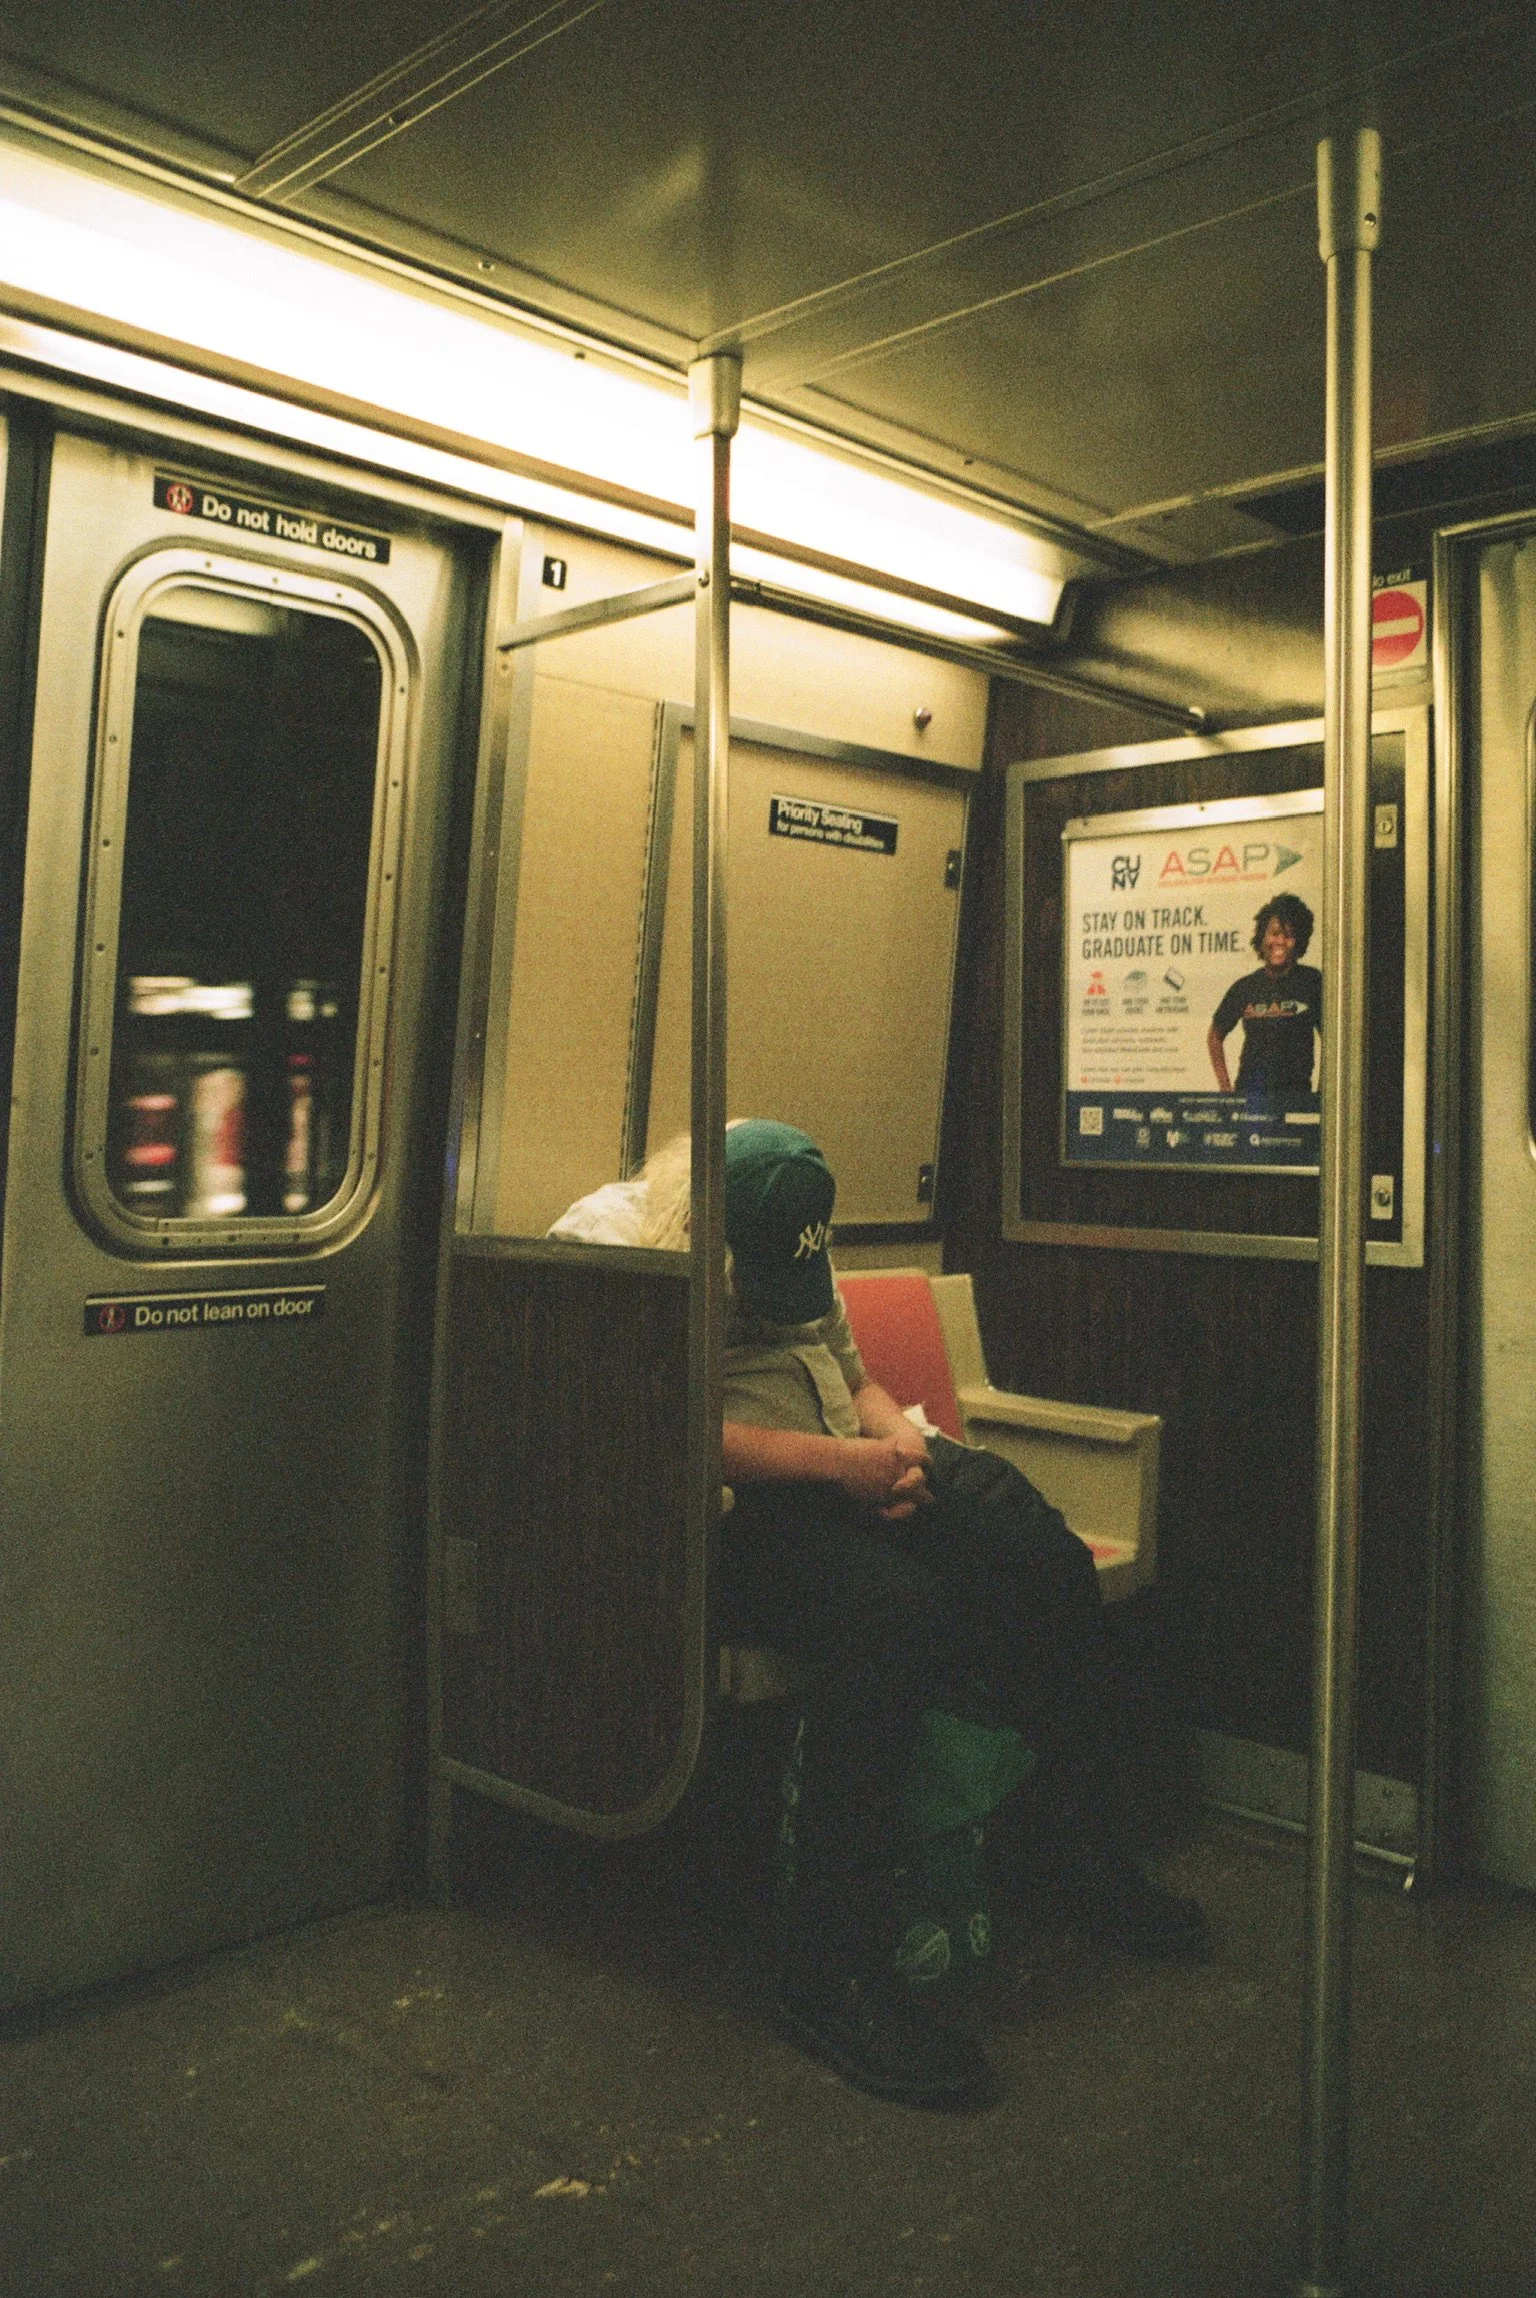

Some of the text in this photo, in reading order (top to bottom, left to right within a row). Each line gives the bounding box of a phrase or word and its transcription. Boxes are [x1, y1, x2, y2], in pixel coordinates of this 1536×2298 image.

[202, 495, 376, 559] Do not hold doors
[551, 562, 562, 587] 1
[1387, 568, 1411, 584] exit
[777, 800, 862, 835] Priority Seating
[1112, 855, 1141, 874] CU
[1160, 844, 1270, 879] ASAP
[1112, 873, 1140, 891] NY
[1082, 905, 1208, 933] STAY ON TRACK.
[1082, 930, 1246, 960] GRADUATE ON TIME.
[135, 1298, 314, 1326] Do not lean on door
